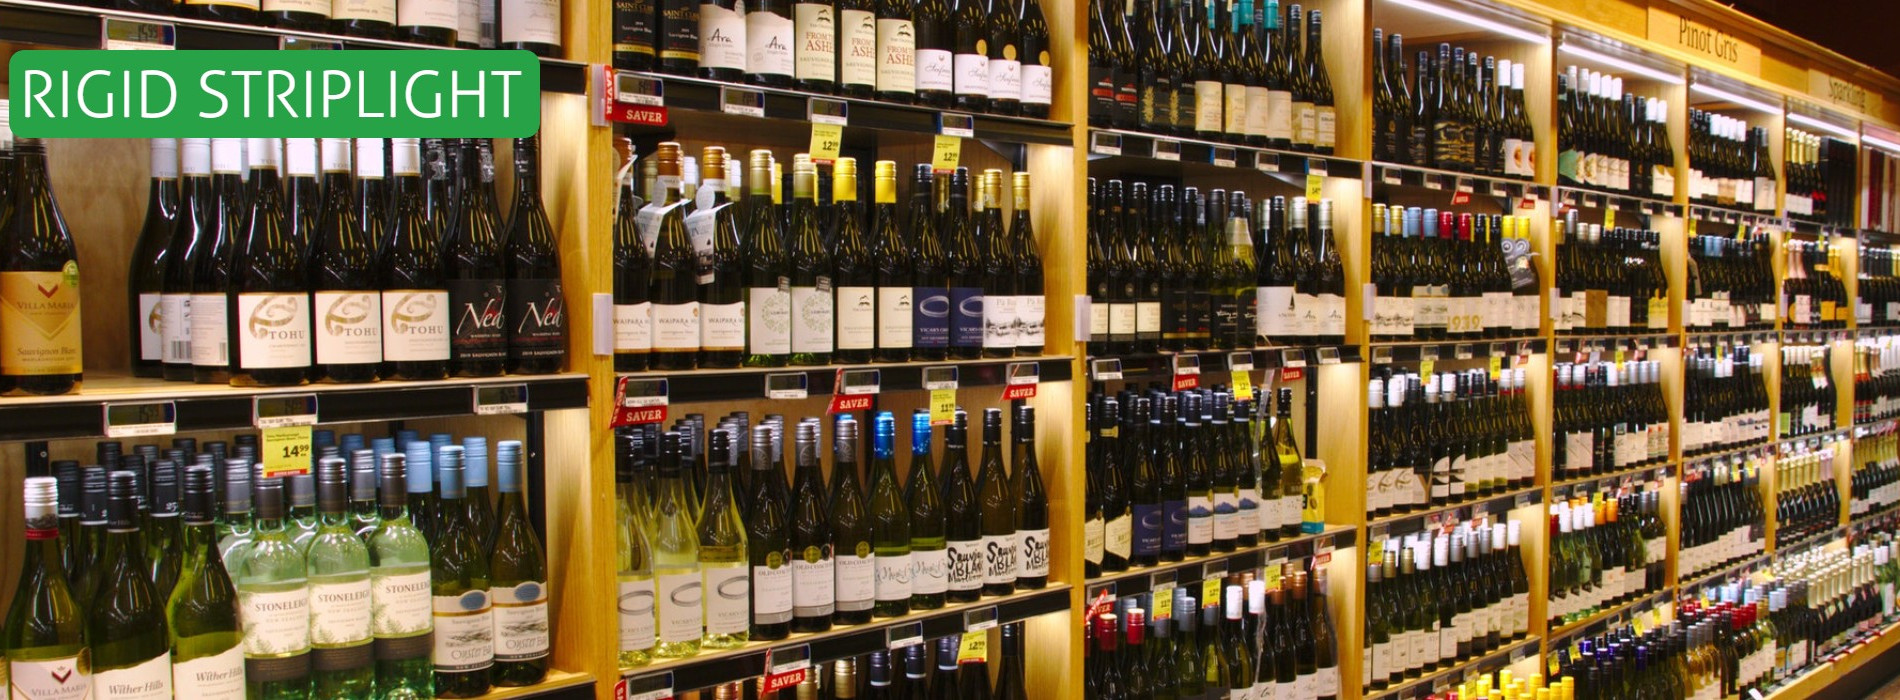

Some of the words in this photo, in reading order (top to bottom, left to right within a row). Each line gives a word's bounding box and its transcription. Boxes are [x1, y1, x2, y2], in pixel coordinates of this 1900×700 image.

[711, 28, 732, 42] Ara
[1678, 15, 1711, 55] Pinot
[1714, 29, 1738, 63] Gris
[769, 35, 787, 50] Ara
[626, 109, 662, 123] SAVER
[16, 301, 46, 310] VILLA
[456, 293, 506, 335] Ned
[518, 293, 563, 334] Ned
[268, 330, 305, 340] TOHU
[344, 327, 377, 337] TOHU
[409, 325, 443, 335] TOHU
[1178, 378, 1196, 389] SAVER
[1010, 387, 1034, 398] SAVER
[839, 398, 869, 410] SAVER
[626, 409, 661, 422] SAVER
[196, 671, 227, 681] Wither
[770, 672, 802, 688] SAVER
[31, 688, 59, 697] VILLA
[109, 684, 142, 695] Wither
[144, 680, 164, 693] Hills
